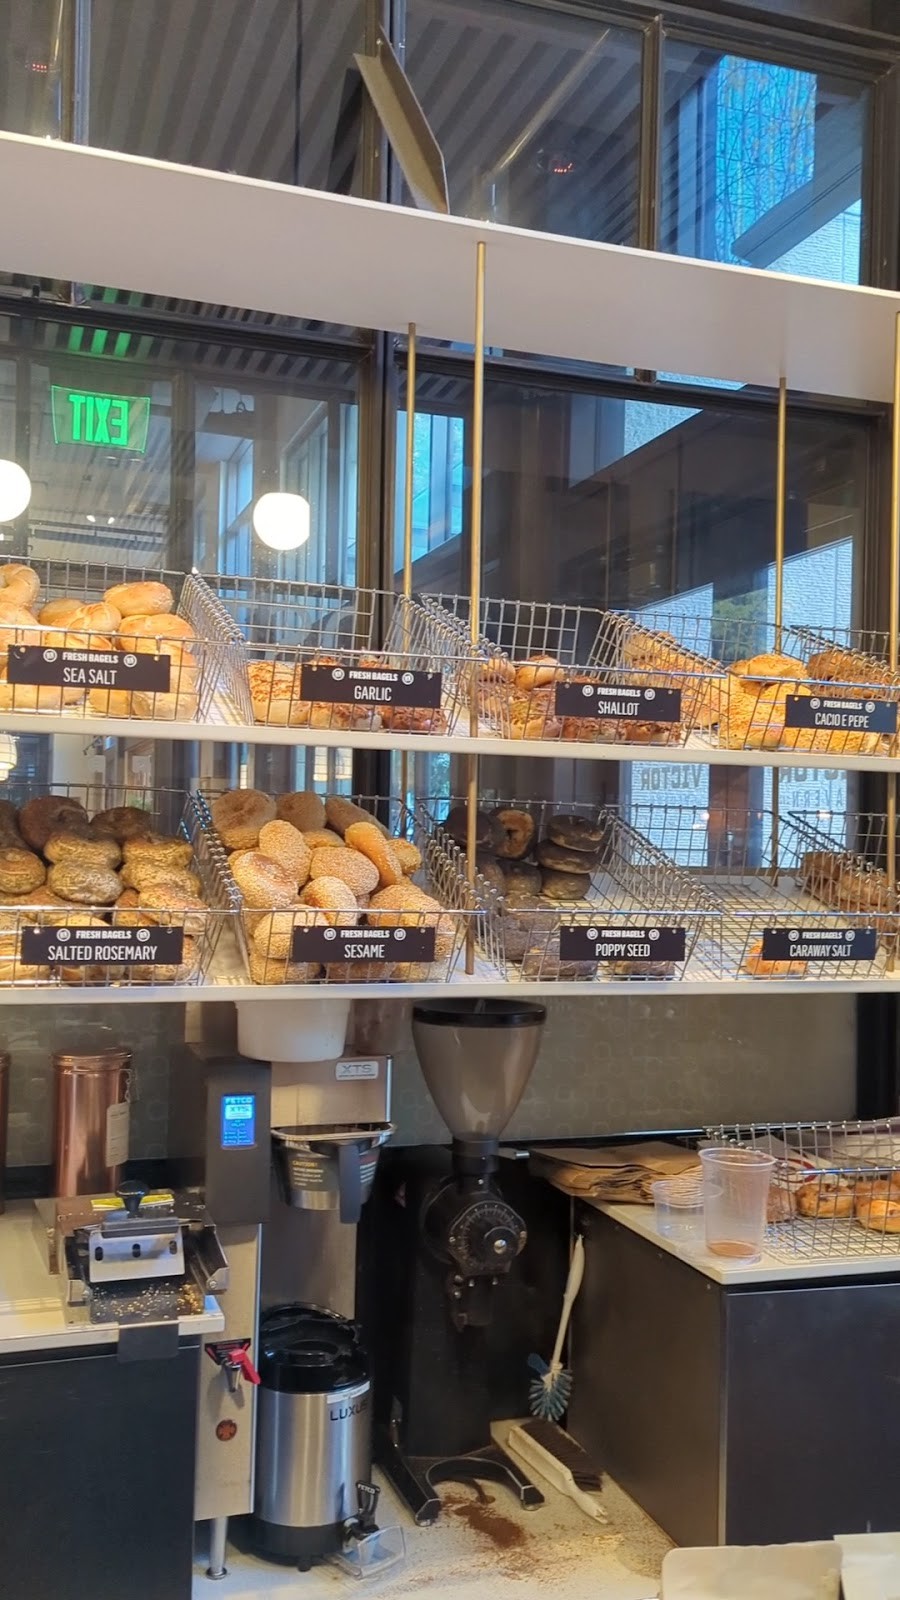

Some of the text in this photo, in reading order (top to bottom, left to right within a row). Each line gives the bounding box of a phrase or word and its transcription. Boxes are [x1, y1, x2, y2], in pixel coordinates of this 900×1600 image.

[62, 651, 119, 664] FRESH BAGELS
[63, 667, 118, 685] SEA SALT
[349, 670, 398, 682] FRESH BAGELS
[354, 685, 392, 701] GARLIC
[597, 687, 641, 698] FRESH BAGELS
[597, 700, 640, 716] SHALLOT
[823, 700, 863, 710] FRESH BAGELS
[815, 712, 869, 728] CACIO E PEPE
[76, 930, 132, 940] FRESH BAGELS
[340, 929, 390, 939] FRESH BAGELS
[601, 930, 646, 938] FRESH BAGELS
[802, 931, 843, 939] FRESH BAGELS
[48, 945, 158, 961] SALTED ROSEMARY
[344, 944, 385, 959] SESAME
[595, 943, 651, 957] POPPY SEED
[789, 944, 853, 957] CARAWAY SALT
[342, 1064, 372, 1074] XTS
